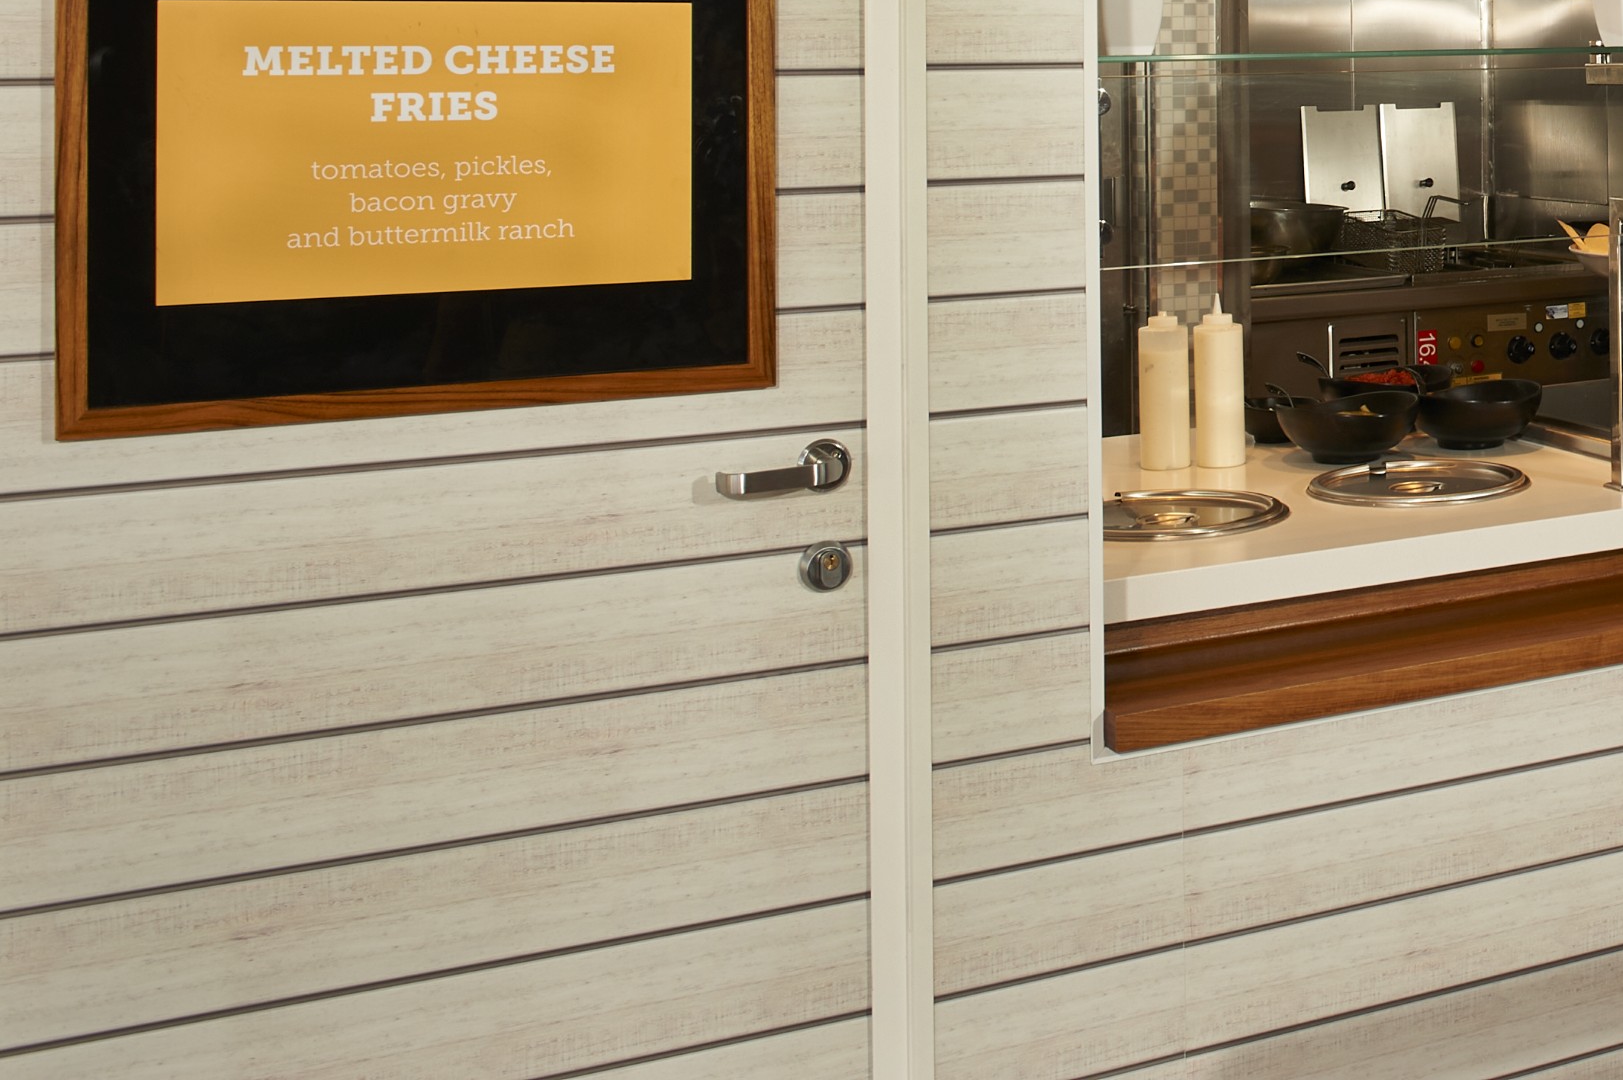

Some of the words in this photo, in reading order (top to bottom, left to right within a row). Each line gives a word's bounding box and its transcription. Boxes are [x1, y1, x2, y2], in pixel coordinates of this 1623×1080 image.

[242, 45, 433, 77] MELTED
[444, 44, 617, 76] CHEESE
[370, 91, 498, 123] FRIES
[311, 157, 447, 182] tomatoes,
[455, 155, 552, 181] pickles,
[350, 192, 435, 213] bacon
[443, 193, 518, 215] gravy
[287, 227, 339, 249] and
[349, 221, 490, 246] buttermilk
[498, 218, 575, 240] ranch
[1418, 332, 1437, 366] 16.
